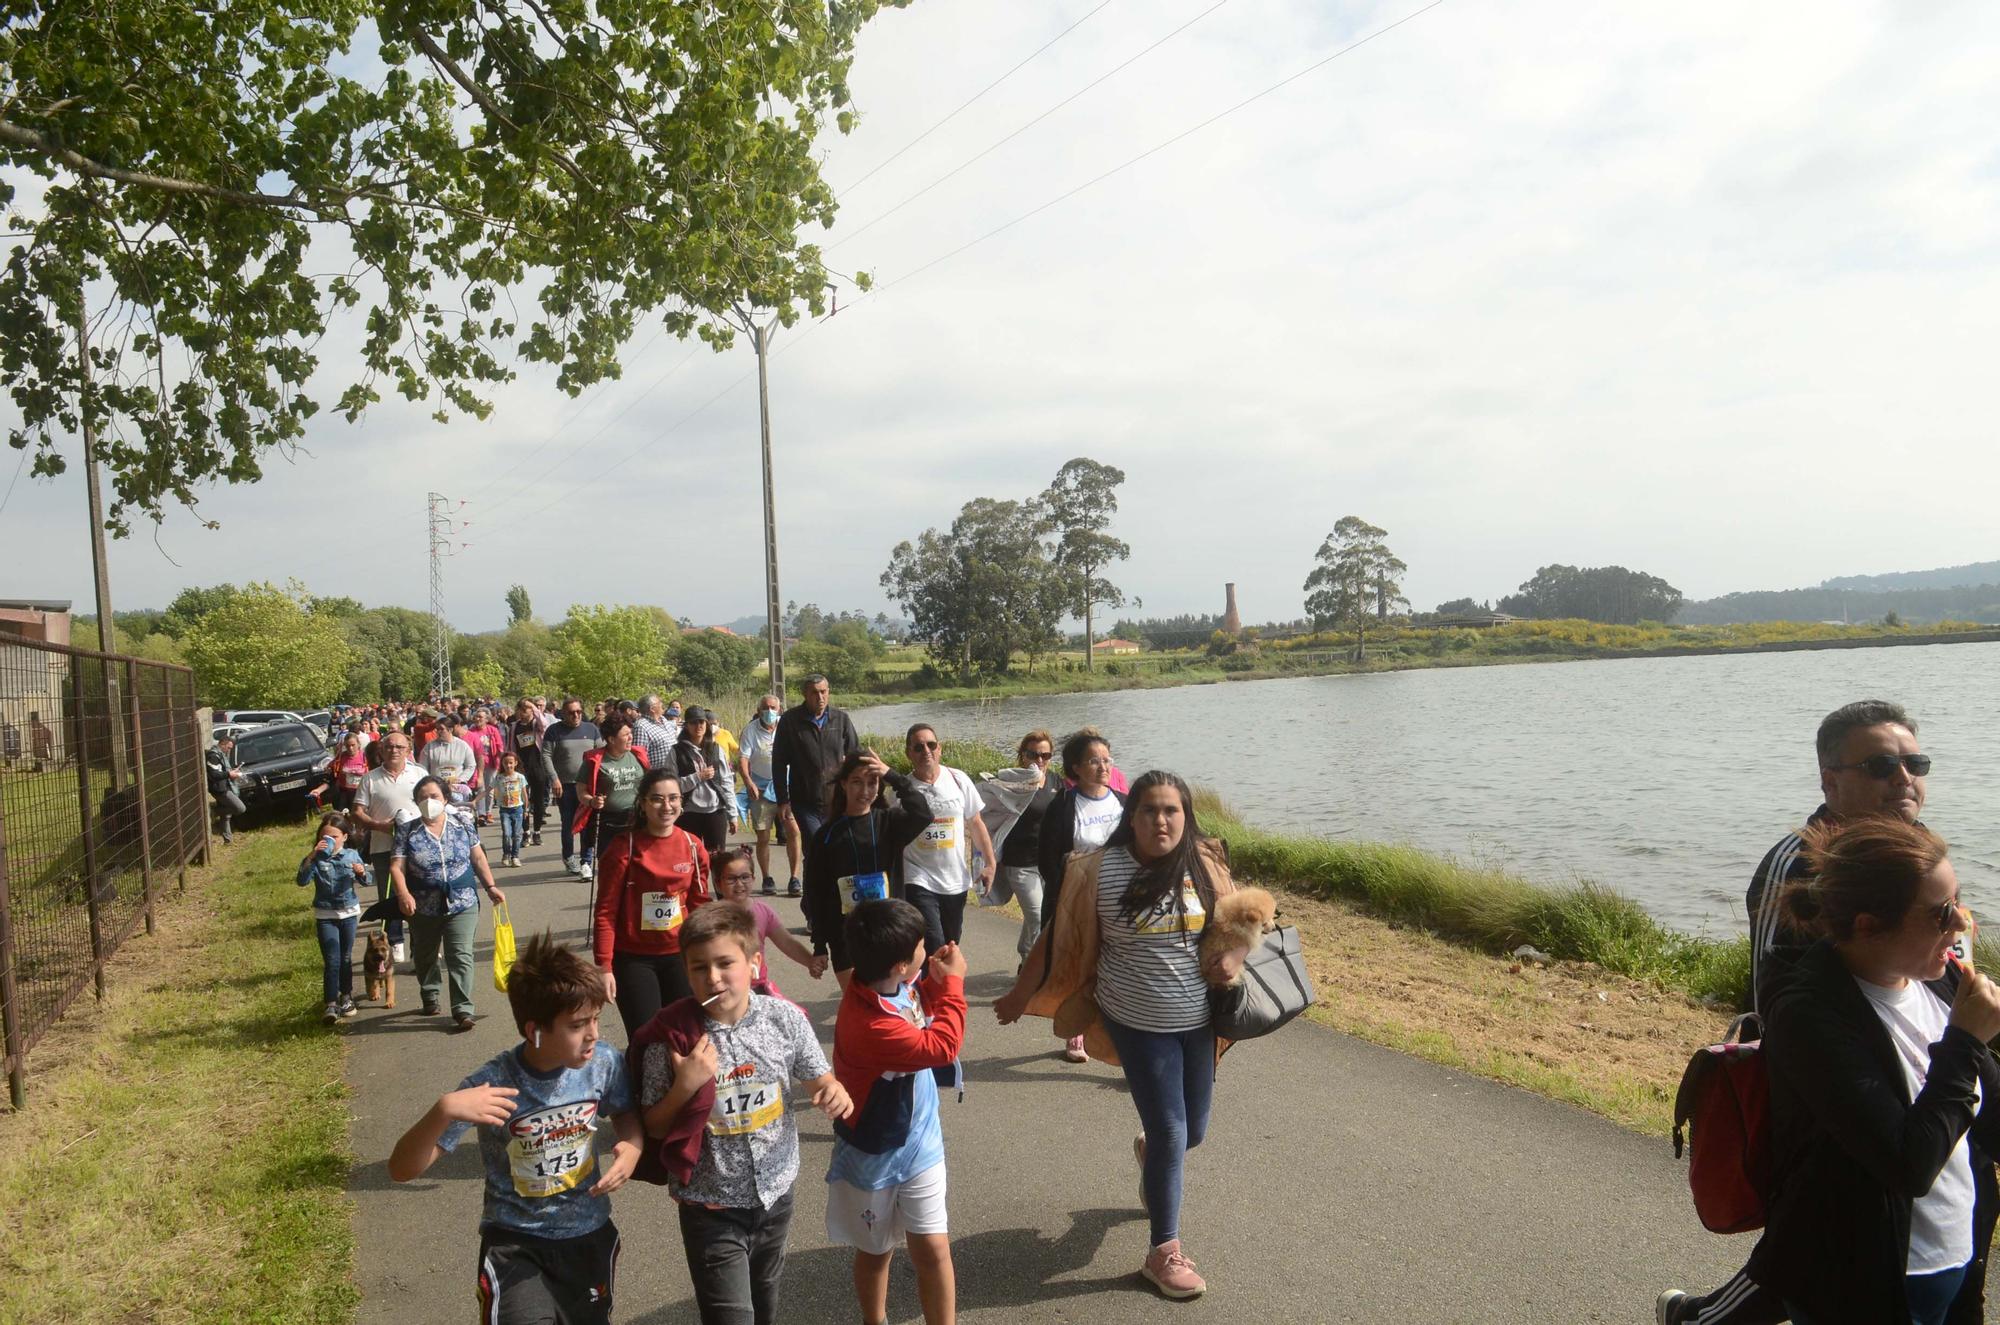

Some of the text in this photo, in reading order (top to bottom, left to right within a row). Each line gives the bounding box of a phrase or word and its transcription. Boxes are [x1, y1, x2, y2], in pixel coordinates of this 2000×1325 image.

[925, 830, 946, 840] 345
[724, 1090, 766, 1115] 174
[534, 1150, 579, 1177] 175
